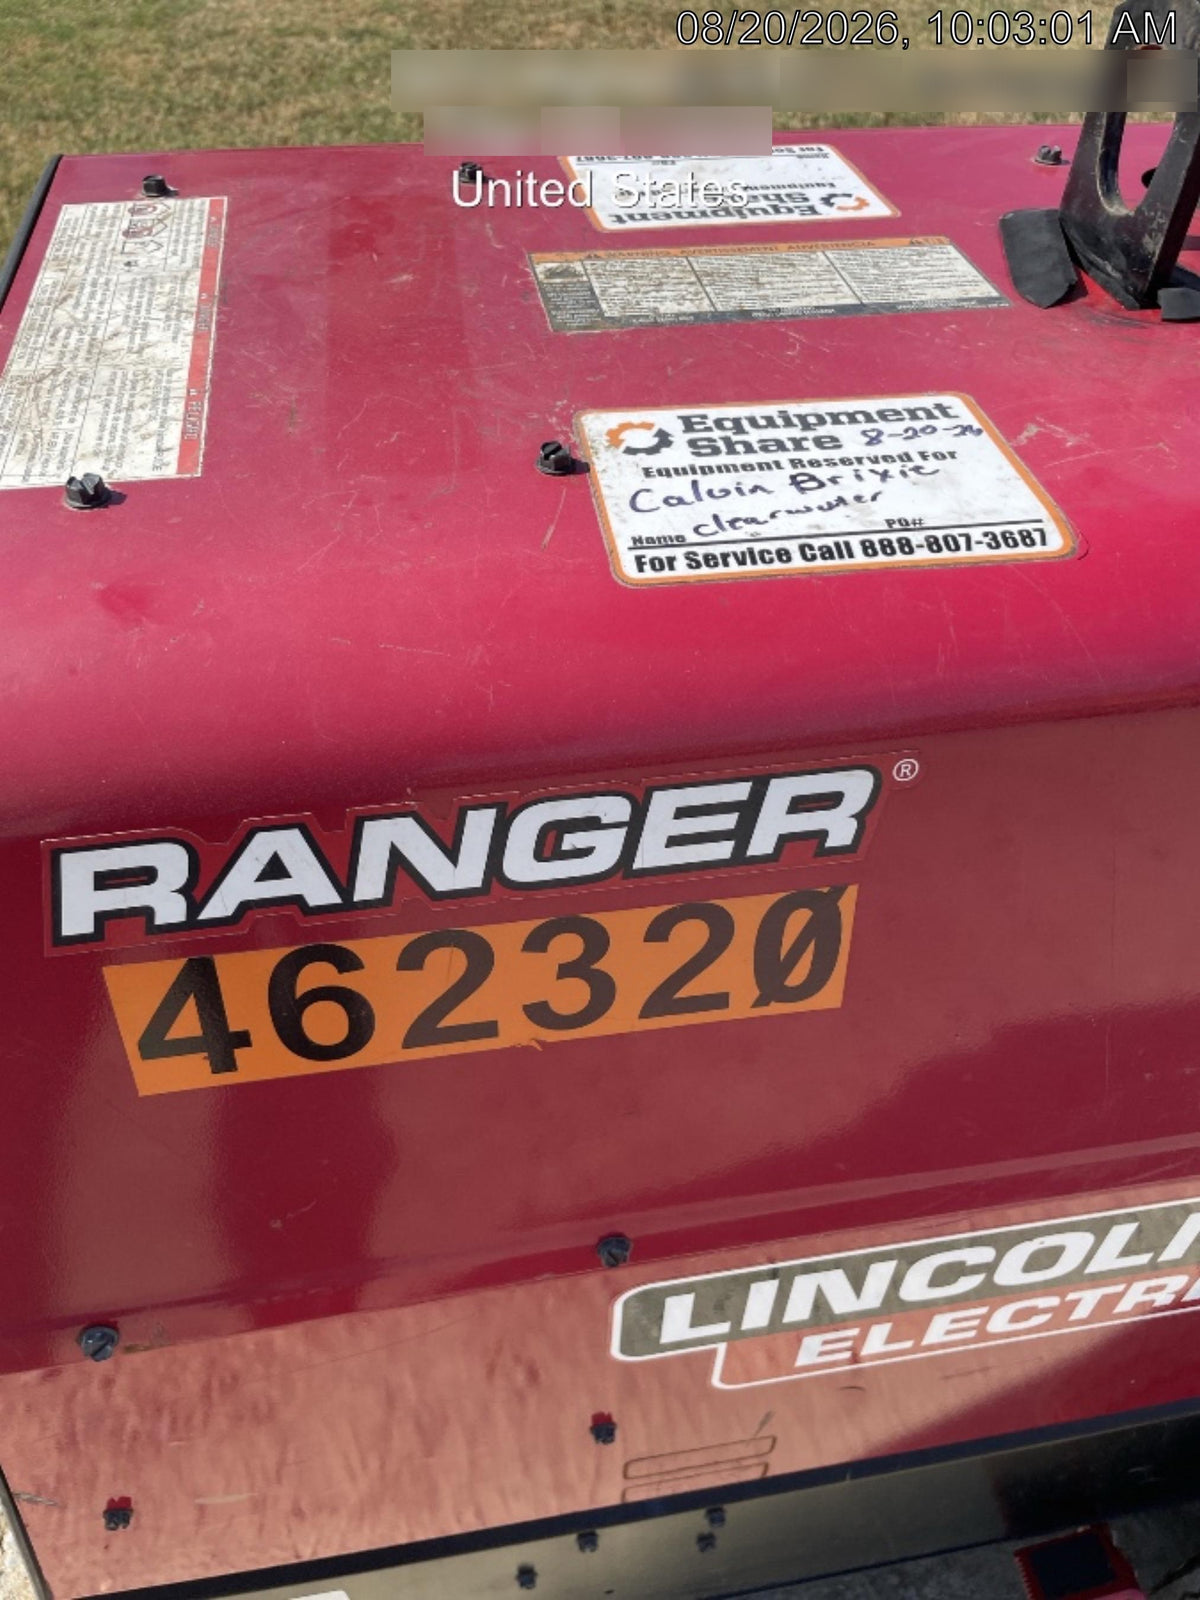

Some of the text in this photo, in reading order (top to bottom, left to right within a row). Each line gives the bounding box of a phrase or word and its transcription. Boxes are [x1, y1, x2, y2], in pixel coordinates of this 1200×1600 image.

[609, 204, 823, 225] Equipment
[677, 403, 960, 435] Equipment
[686, 435, 843, 458] Share
[642, 450, 958, 478] Equipment Reserved For
[631, 517, 925, 546] Name PO#
[634, 528, 1047, 574] For Service Call 888-807-3687
[58, 768, 876, 938] RANGER
[136, 887, 850, 1075] 462320
